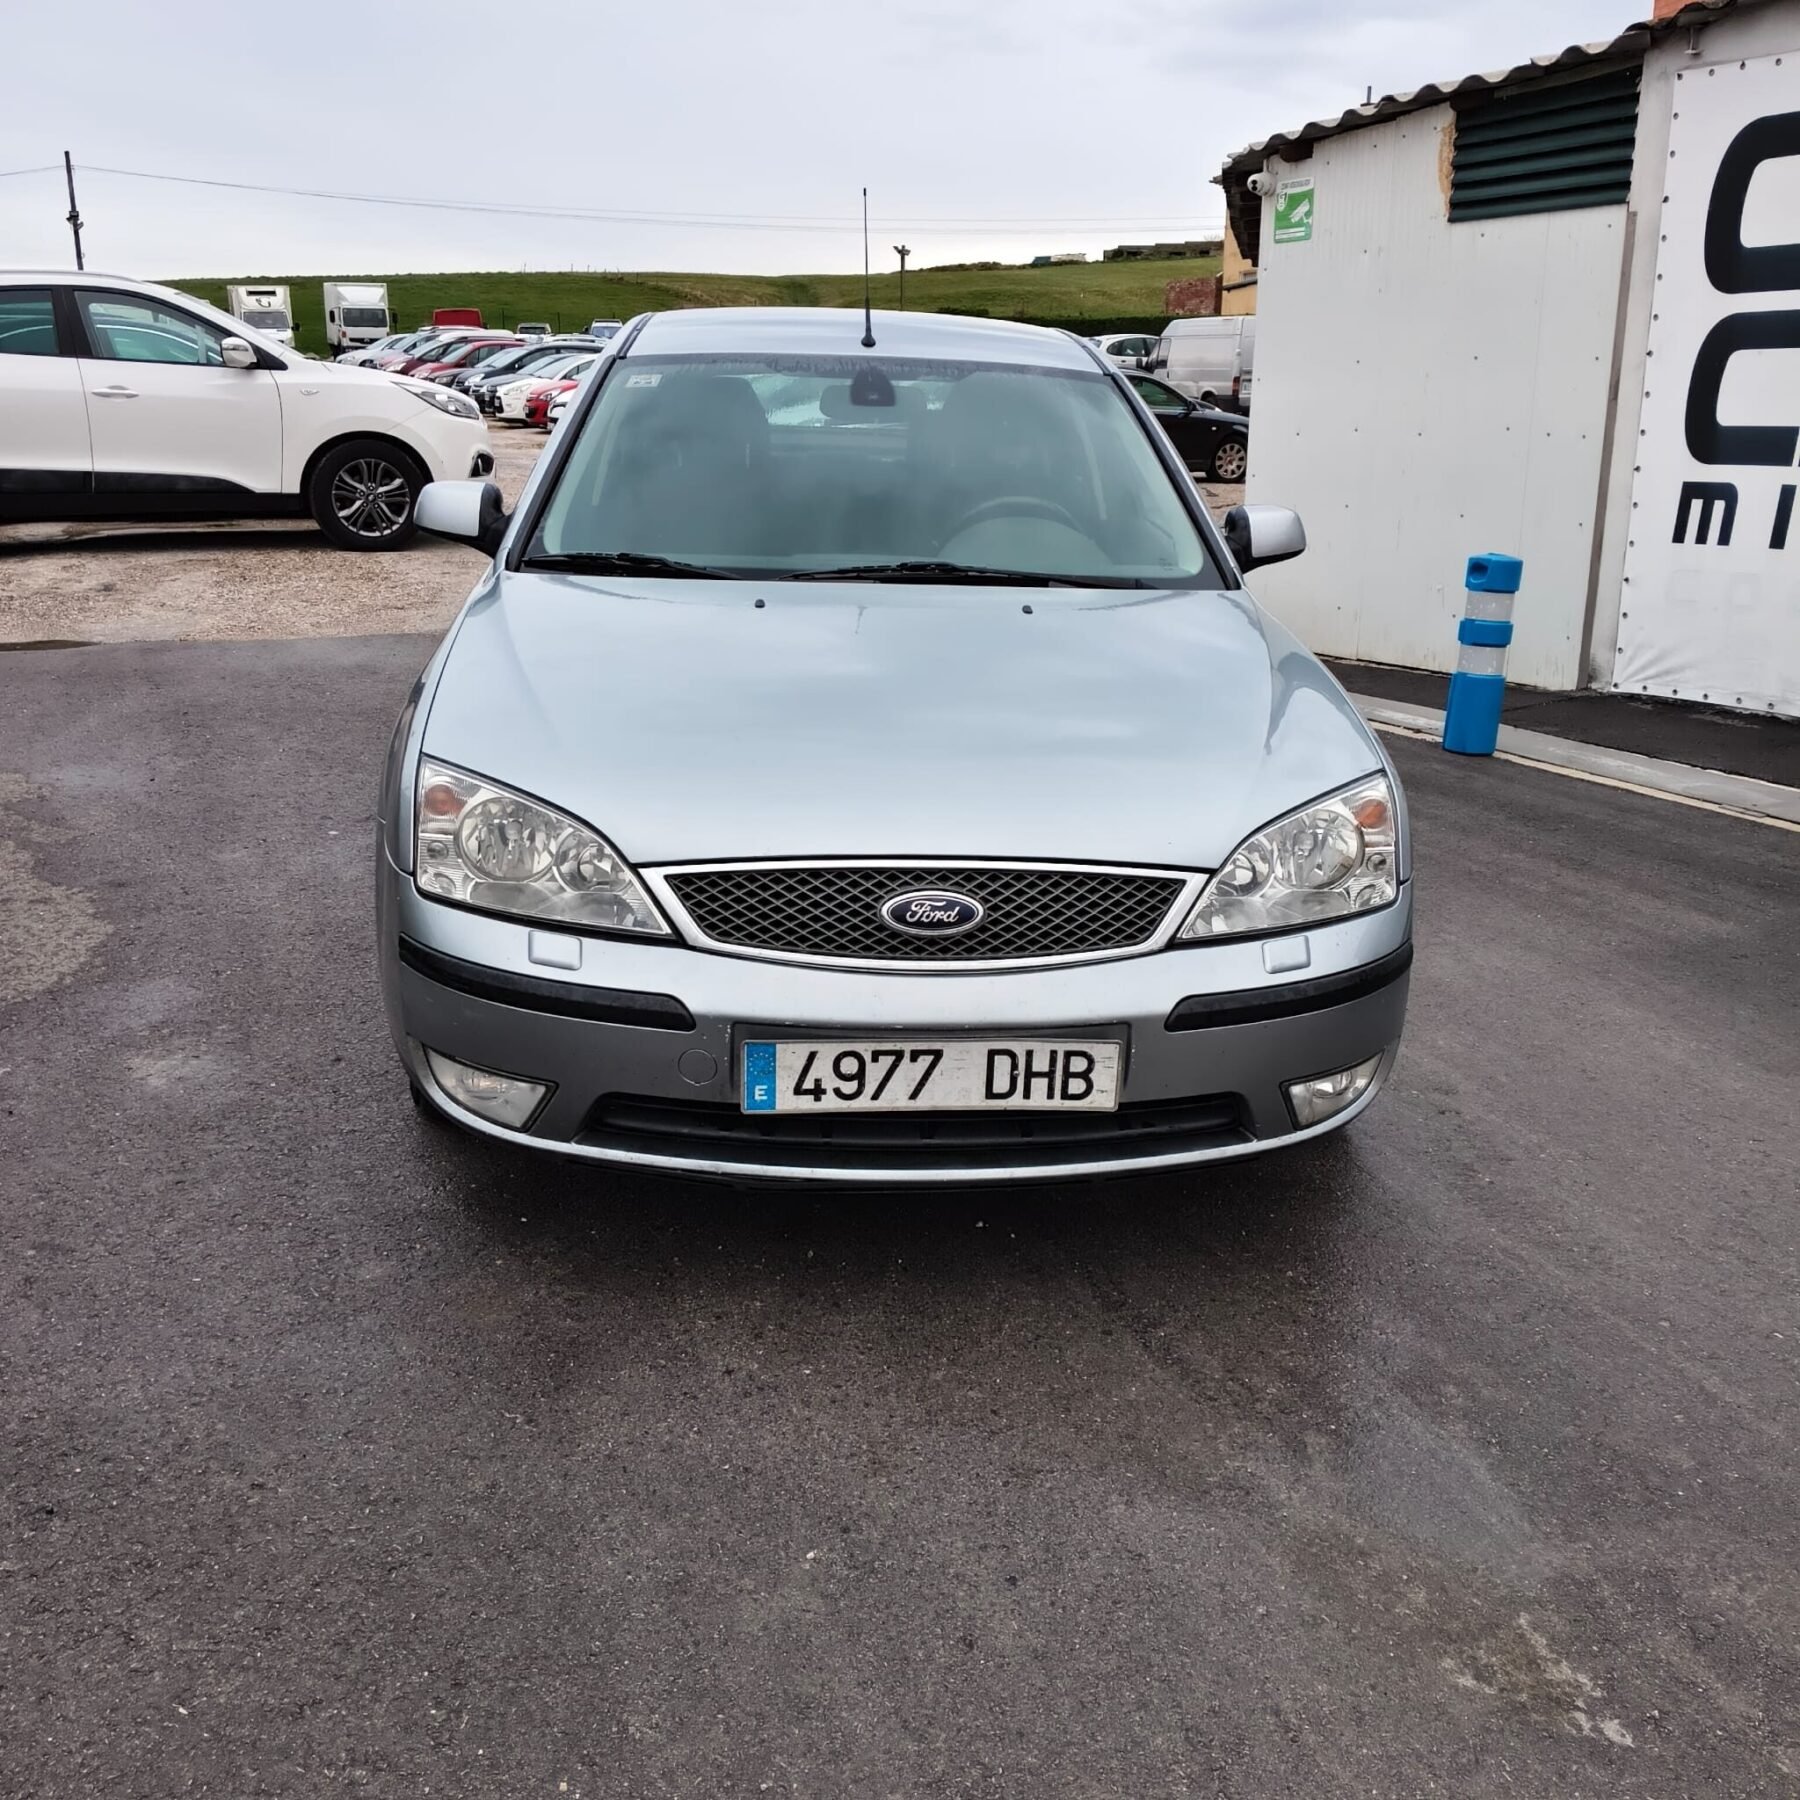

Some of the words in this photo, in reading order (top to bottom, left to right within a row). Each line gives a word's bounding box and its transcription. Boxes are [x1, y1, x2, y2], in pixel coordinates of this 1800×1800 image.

[906, 900, 960, 922] Ford
[792, 1049, 944, 1102] 4977
[984, 1048, 1096, 1101] DHB
[755, 1085, 767, 1100] E
